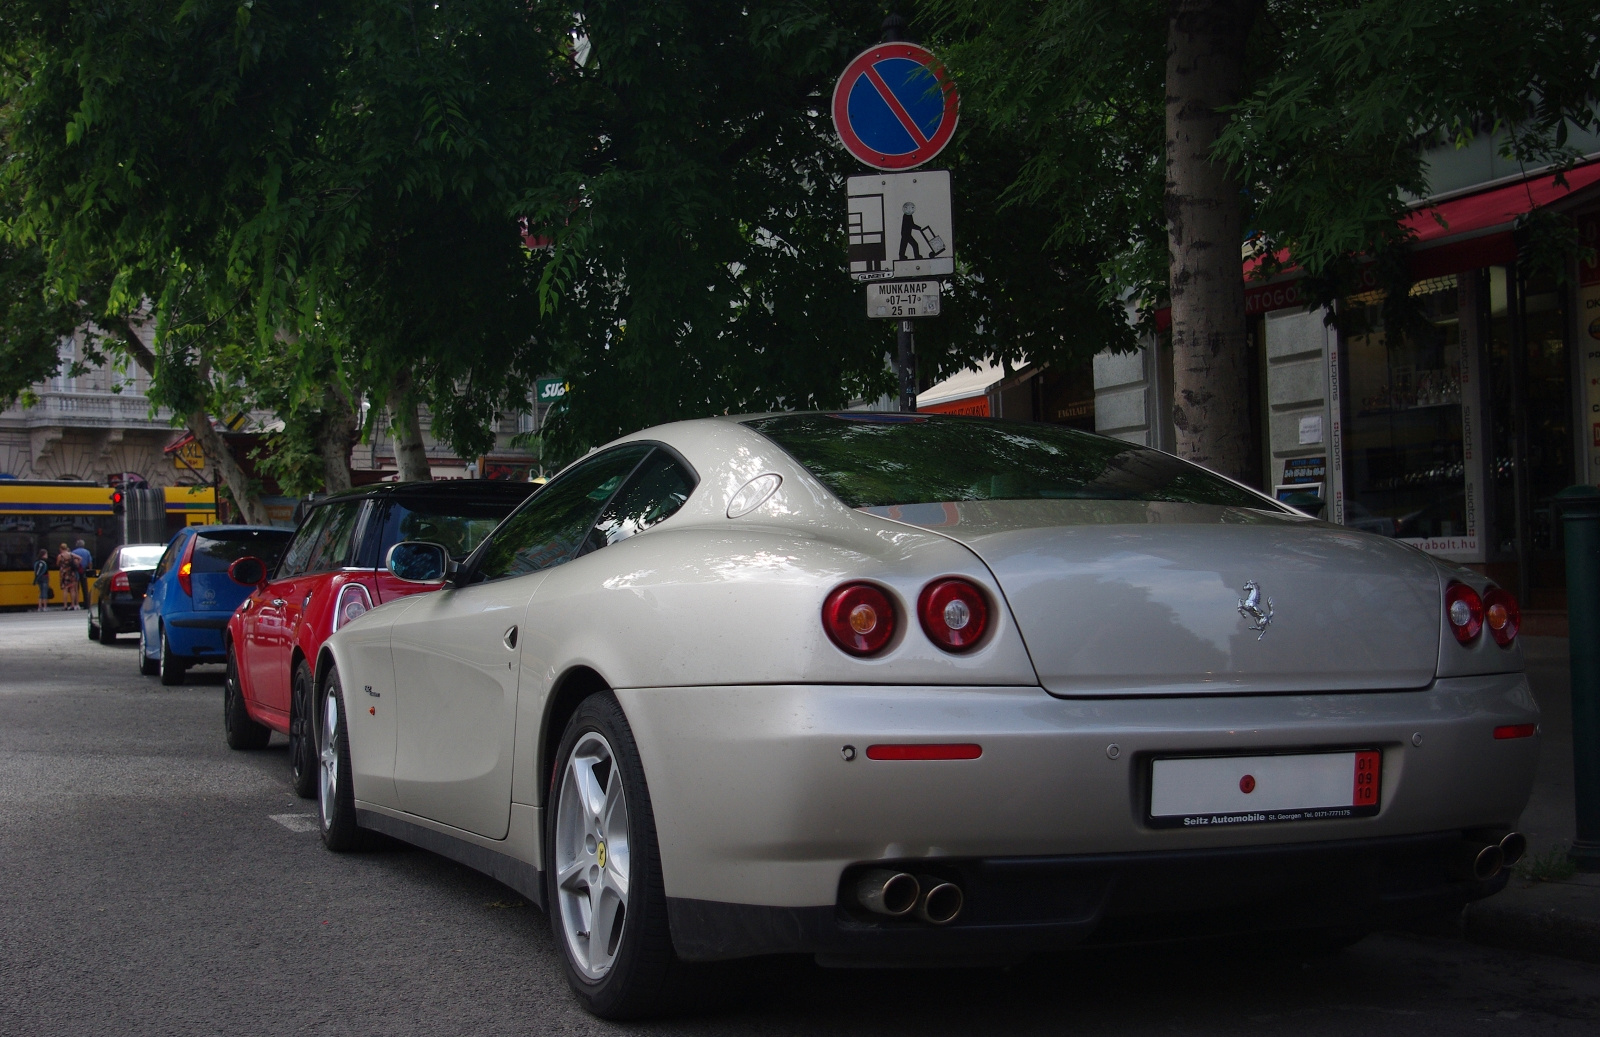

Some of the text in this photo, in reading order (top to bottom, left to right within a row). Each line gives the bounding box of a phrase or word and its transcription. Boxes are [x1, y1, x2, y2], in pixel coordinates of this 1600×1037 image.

[879, 283, 927, 295] MUNKANAP
[890, 295, 917, 304] 07-17
[1246, 286, 1307, 311] KTOGO
[892, 306, 916, 316] 25 m
[1461, 330, 1470, 375] swatch
[1331, 361, 1340, 402] swatch
[541, 382, 569, 399] SUB
[1464, 405, 1473, 452] swatch
[1334, 429, 1342, 472] swatch
[1335, 500, 1343, 525] atch
[1467, 483, 1475, 528] swatch
[1359, 758, 1372, 770] 01
[1358, 772, 1372, 785] 09
[1358, 786, 1371, 799] 10
[1183, 816, 1209, 826] Seitz
[1211, 813, 1266, 824] Automobile
